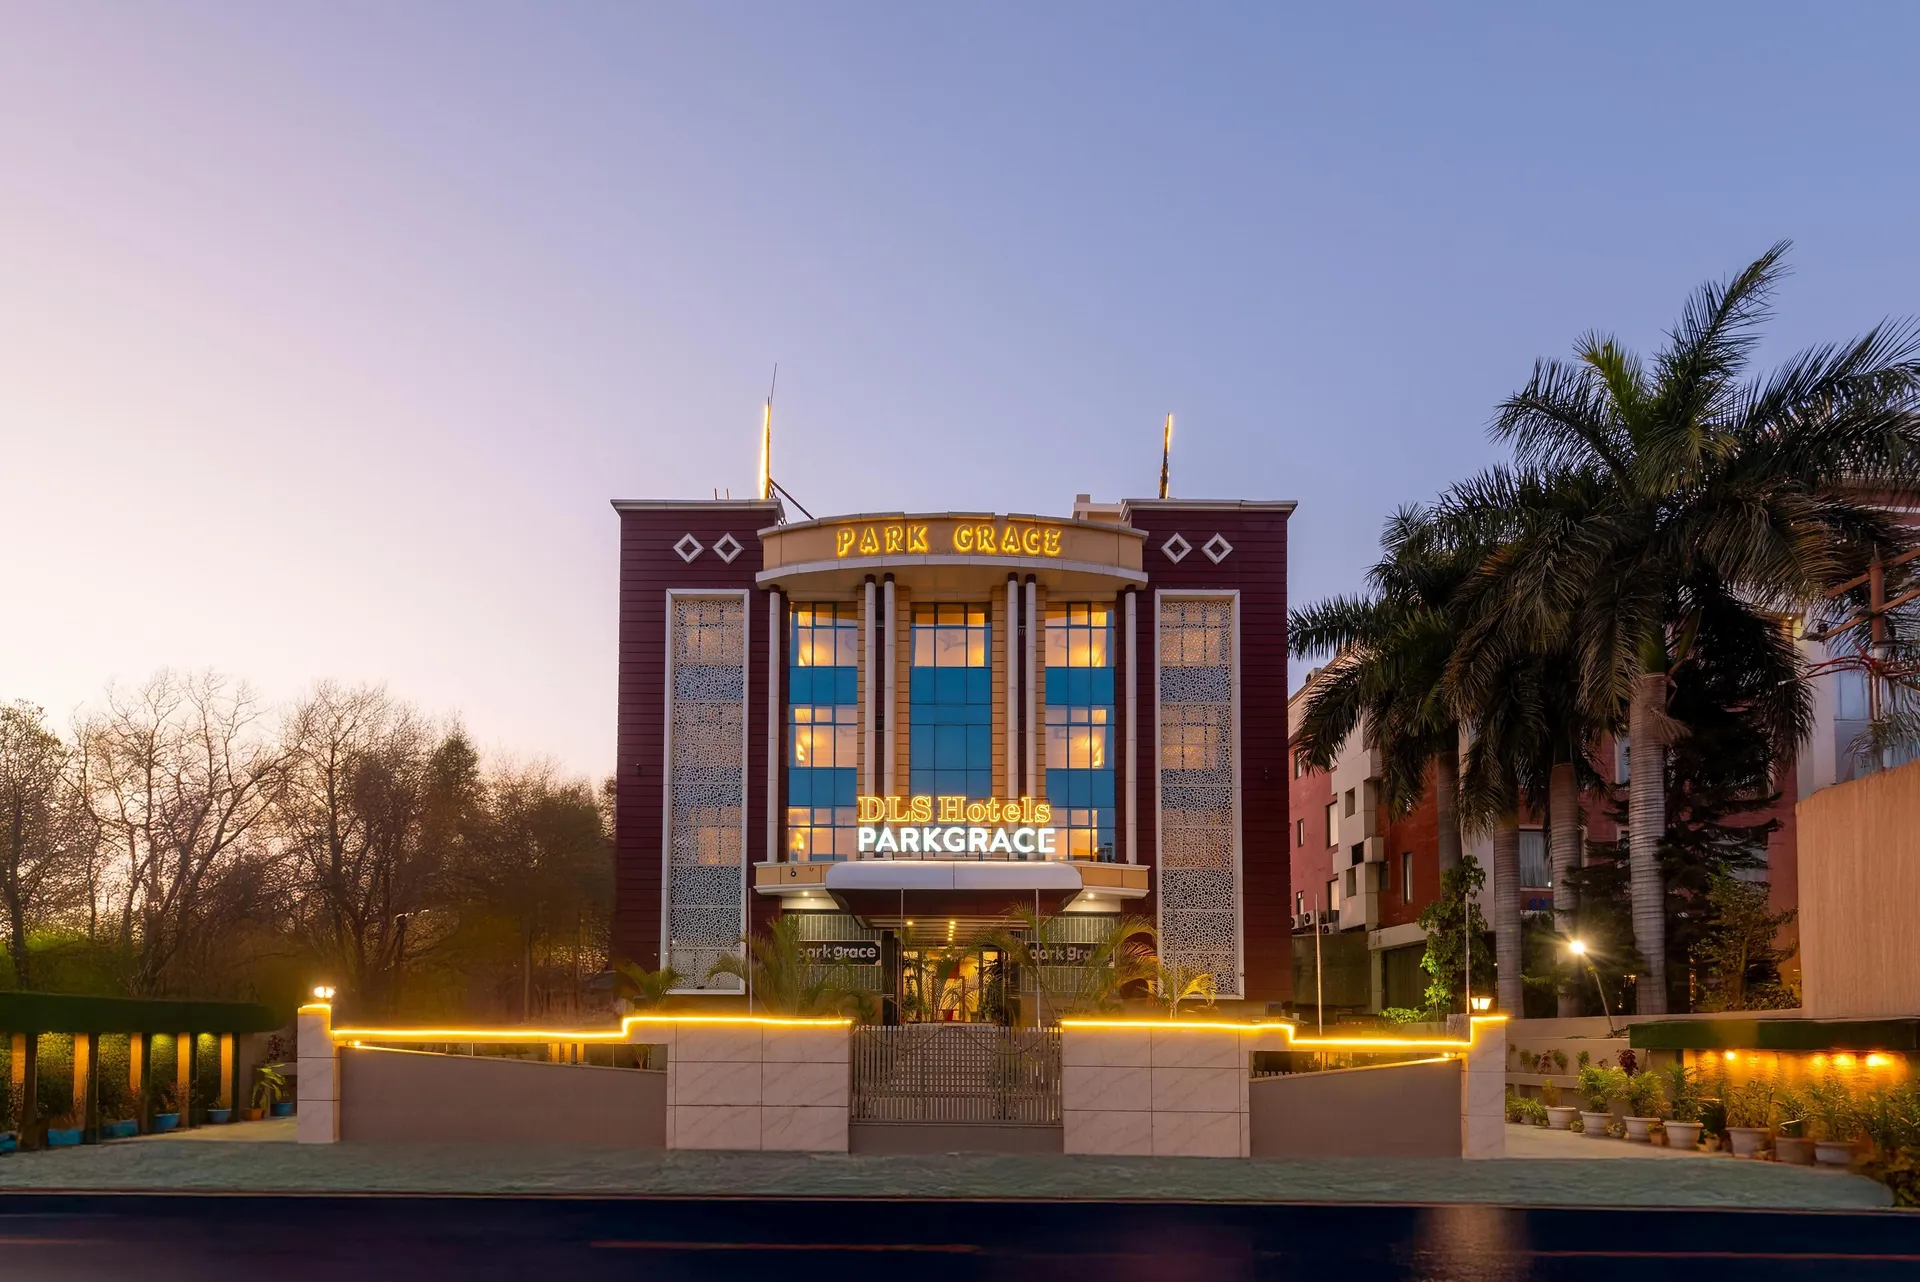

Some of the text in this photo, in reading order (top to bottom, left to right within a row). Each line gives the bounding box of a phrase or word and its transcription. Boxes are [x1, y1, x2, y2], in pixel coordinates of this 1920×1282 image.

[837, 524, 1061, 557] PARK GRACE
[858, 796, 1051, 823] DLS Hotels
[858, 827, 1056, 853] PARKGRACE
[833, 946, 877, 960] grace
